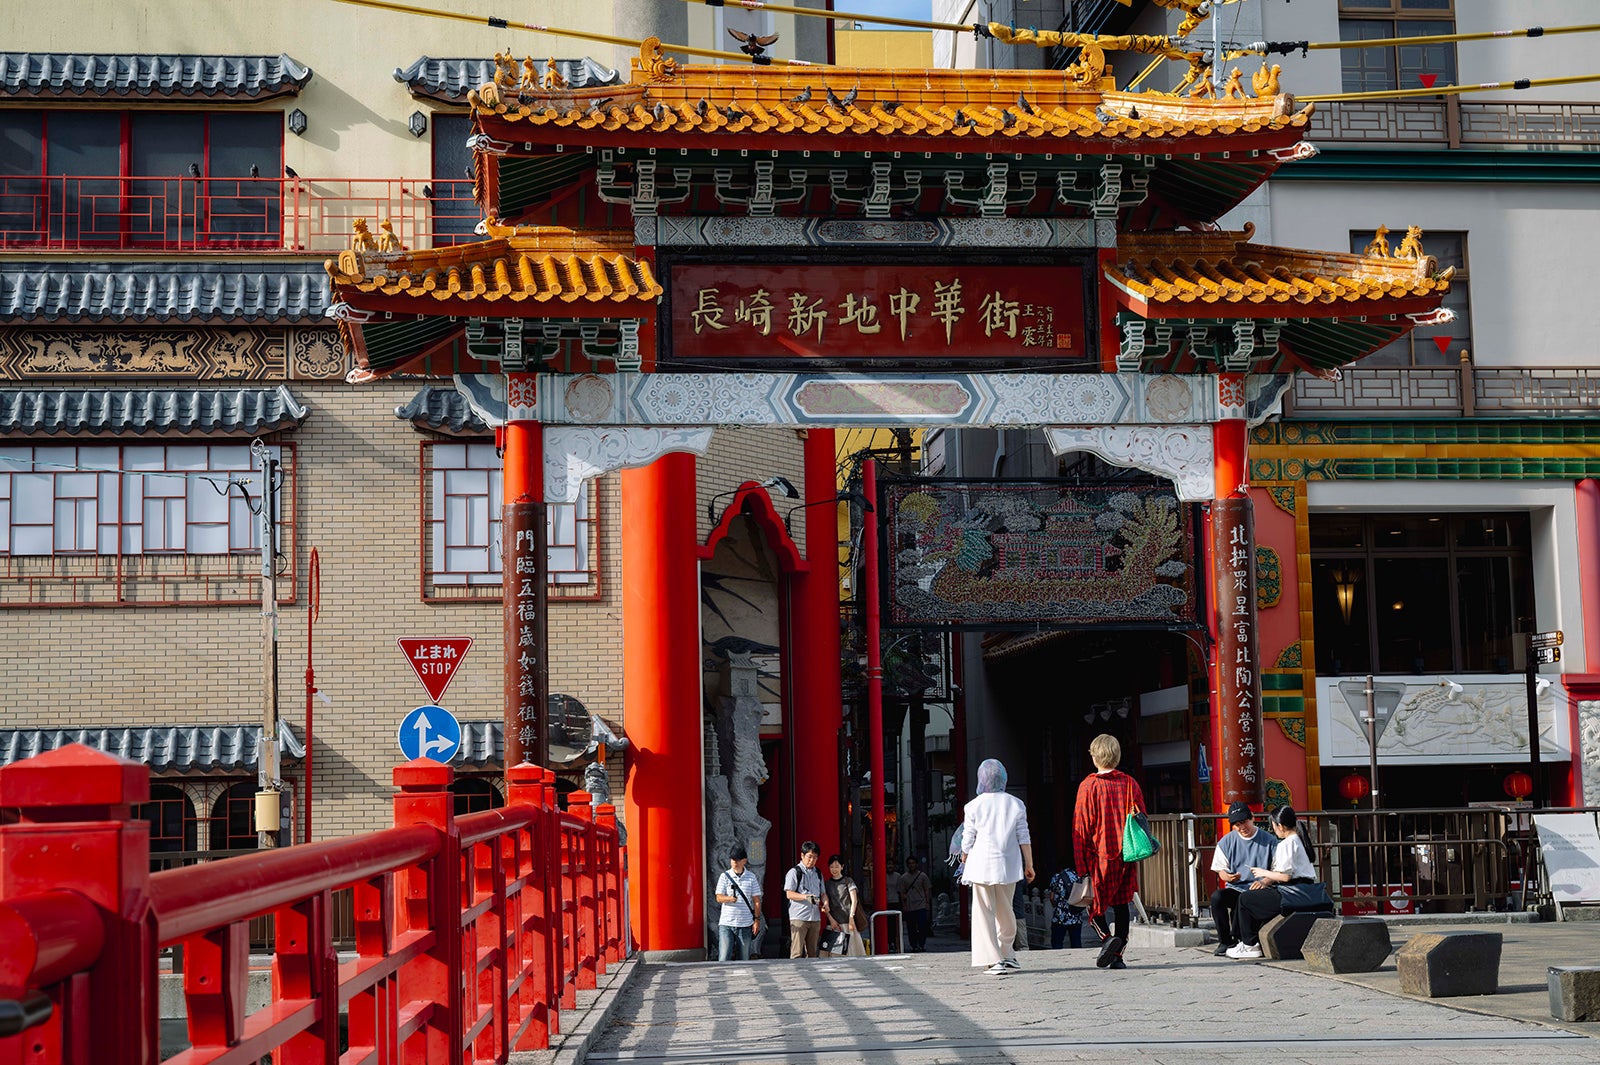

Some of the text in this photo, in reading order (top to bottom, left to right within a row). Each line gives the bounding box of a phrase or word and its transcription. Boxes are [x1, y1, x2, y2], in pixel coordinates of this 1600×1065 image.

[691, 278, 1020, 346] 長崎新地中華街
[1022, 304, 1037, 347] 王震
[413, 644, 458, 659] 止まれ
[421, 662, 452, 675] STOP
